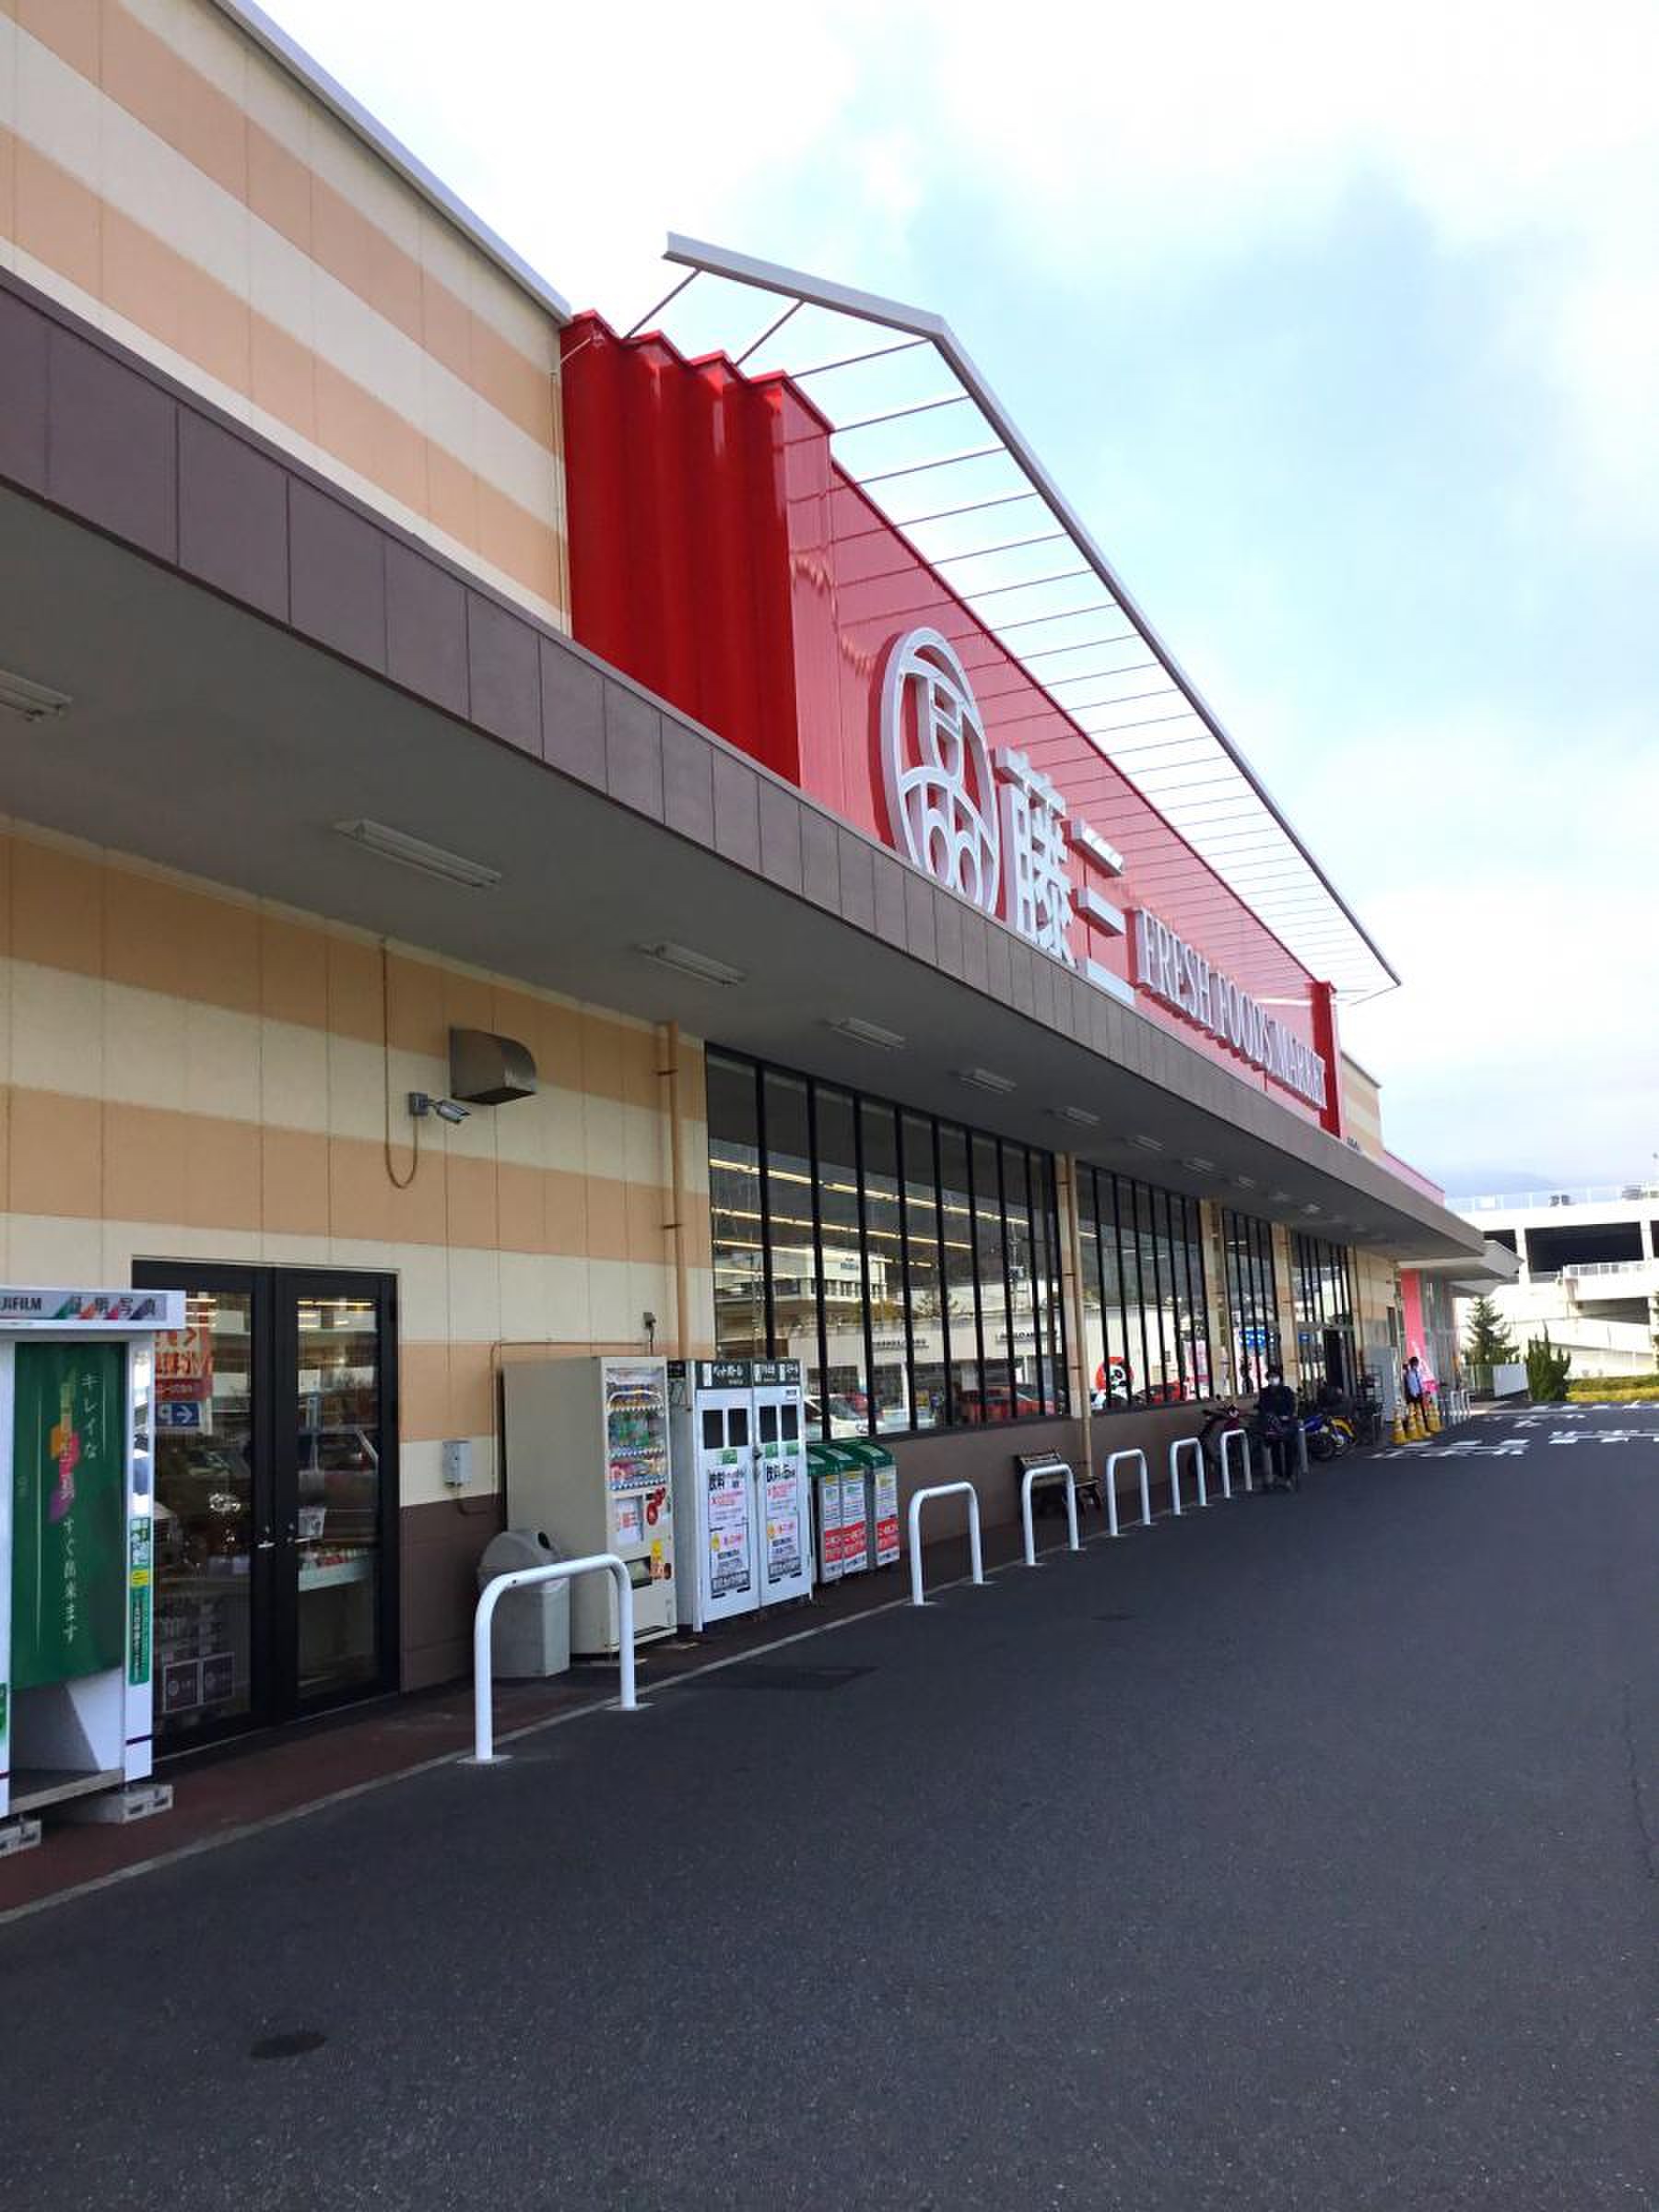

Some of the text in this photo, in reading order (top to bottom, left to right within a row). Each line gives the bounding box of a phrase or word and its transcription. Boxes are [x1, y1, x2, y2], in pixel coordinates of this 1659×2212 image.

[1135, 906, 1213, 1029] FRESH
[81, 1371, 103, 1460] キレイな
